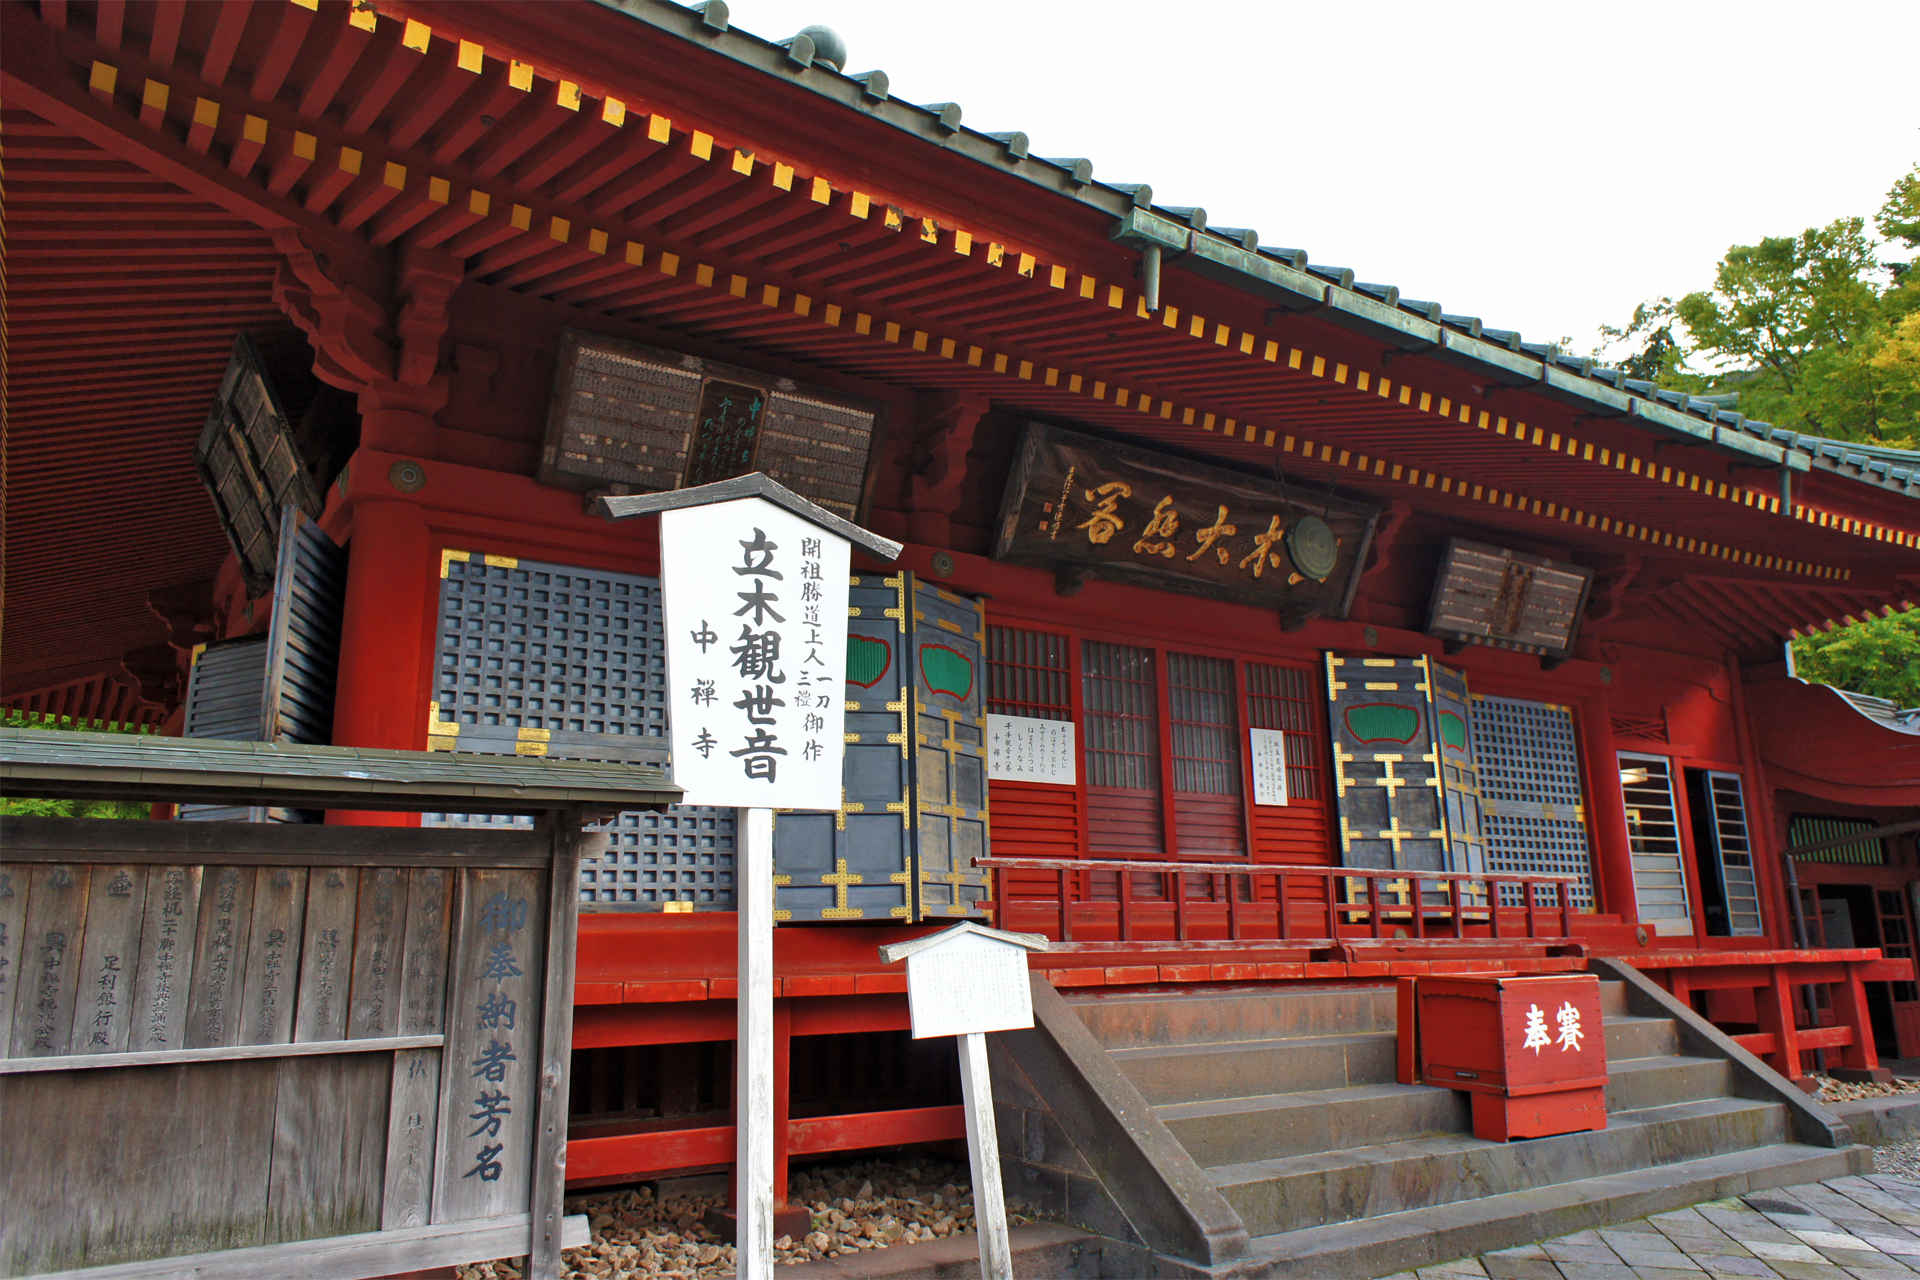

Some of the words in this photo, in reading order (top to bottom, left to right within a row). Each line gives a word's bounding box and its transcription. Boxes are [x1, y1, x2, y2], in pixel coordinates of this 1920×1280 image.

[690, 619, 719, 760] 中禅寺
[729, 527, 788, 784] 立木観世音
[88, 955, 122, 1047] 足利銀行殿
[462, 890, 528, 1183] 御奉納者芳名
